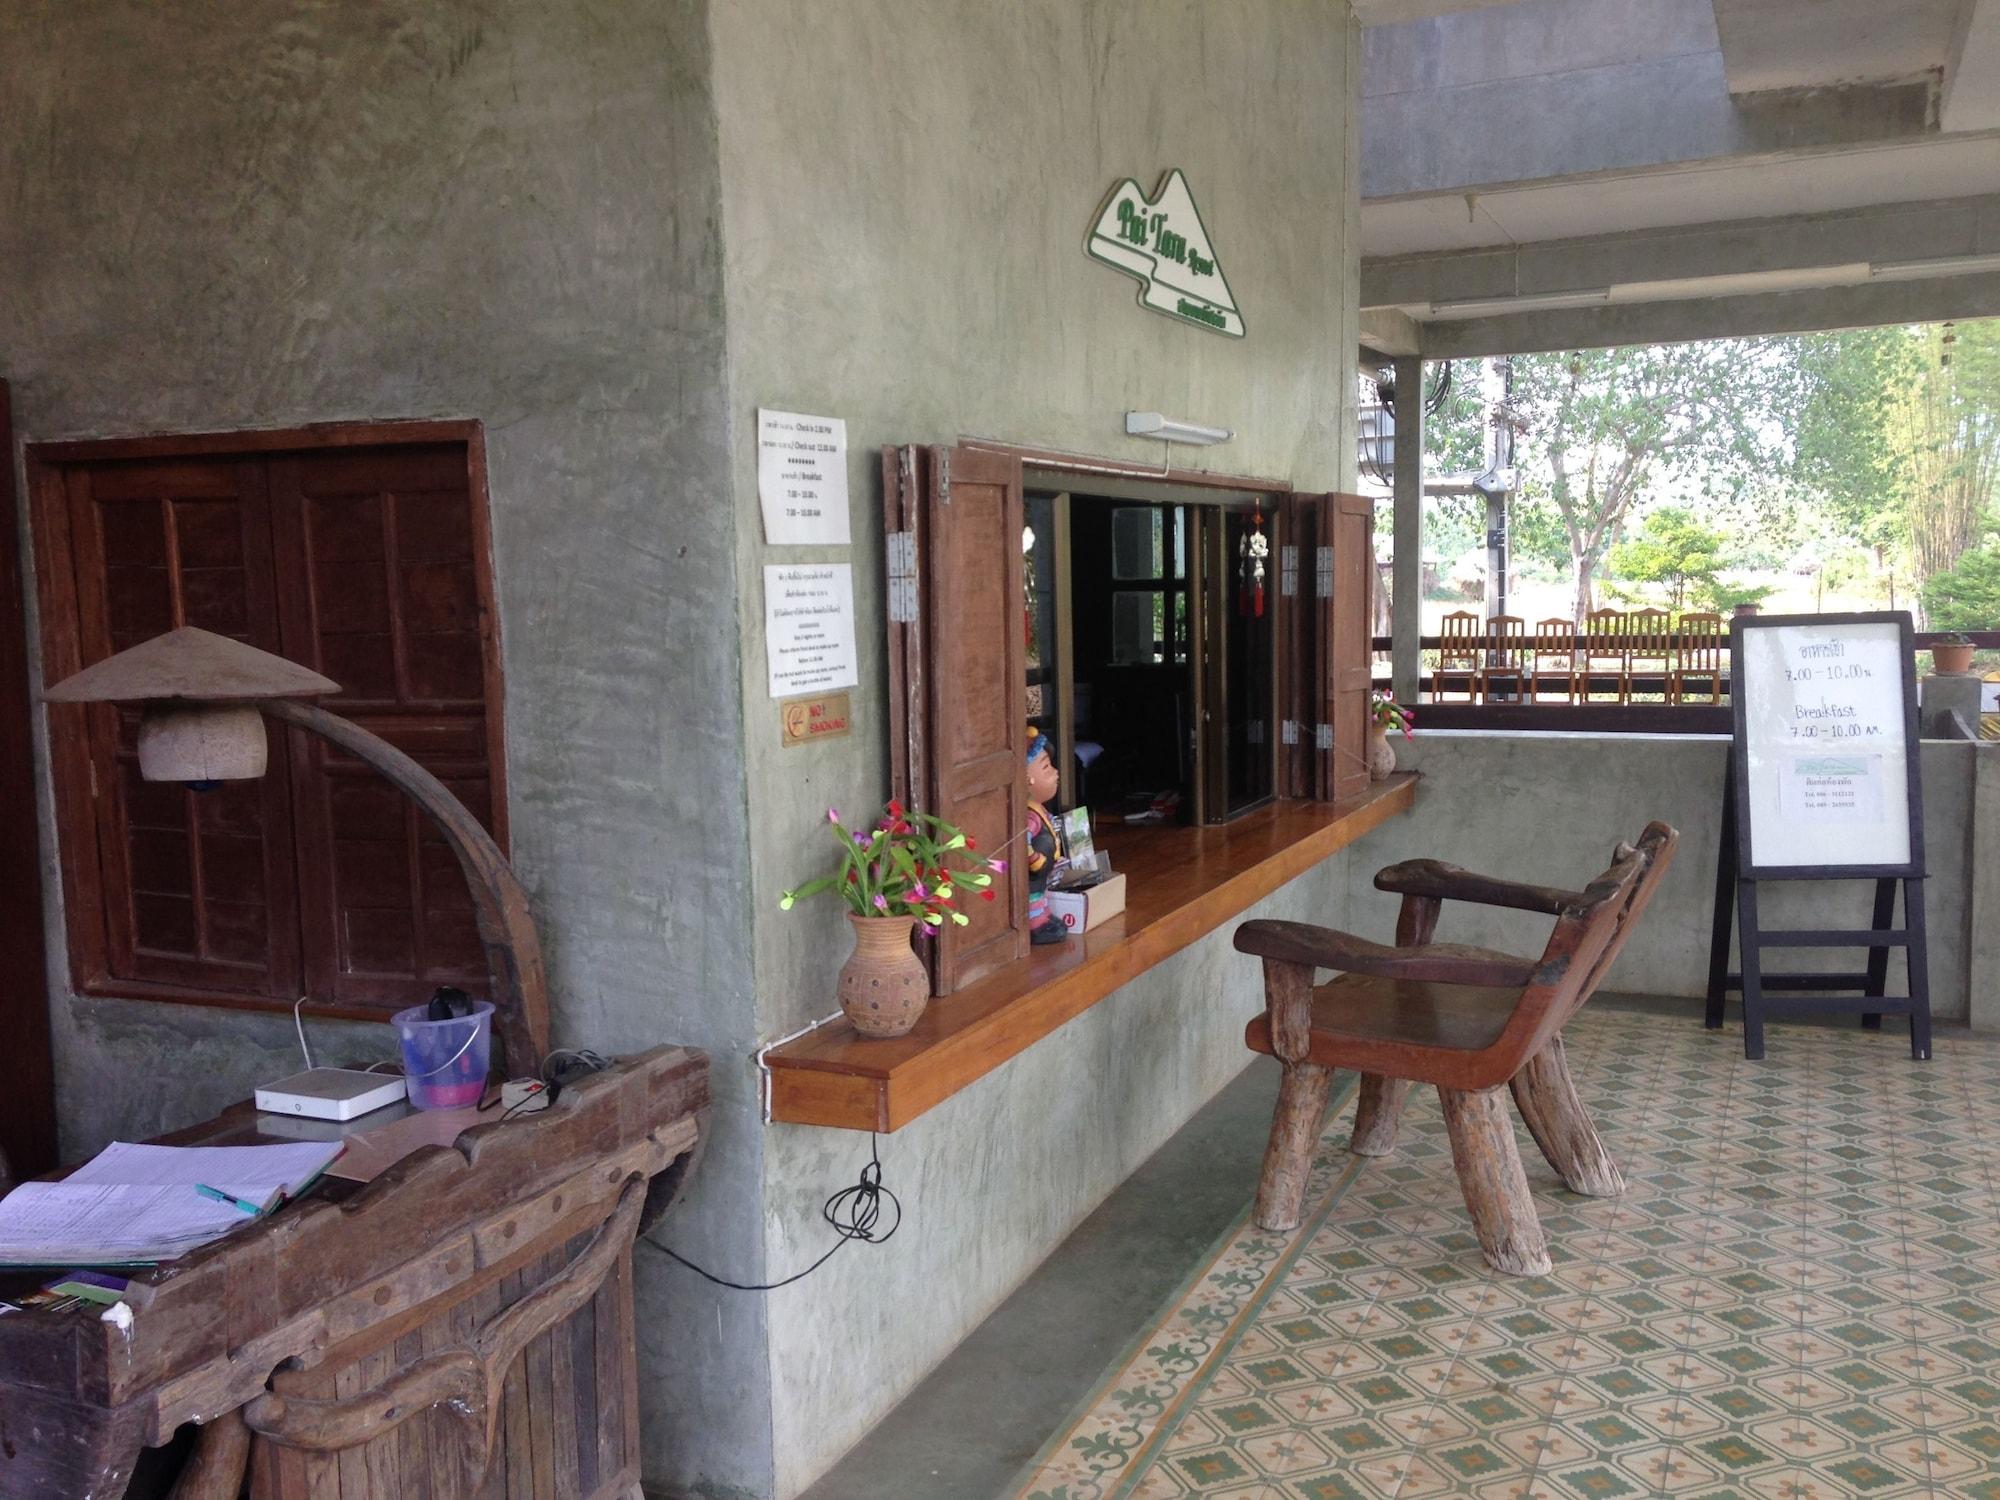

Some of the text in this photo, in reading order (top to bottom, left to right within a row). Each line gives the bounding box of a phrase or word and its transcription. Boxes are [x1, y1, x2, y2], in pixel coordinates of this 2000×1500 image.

[1117, 198, 1148, 246] Pai
[1784, 667, 1812, 681] 7.00
[810, 703, 826, 717] NO
[1795, 698, 1857, 719] Breakfast
[809, 718, 846, 733] SMOKING
[1790, 725, 1818, 738] 7.00
[1832, 723, 1861, 737] 10.00
